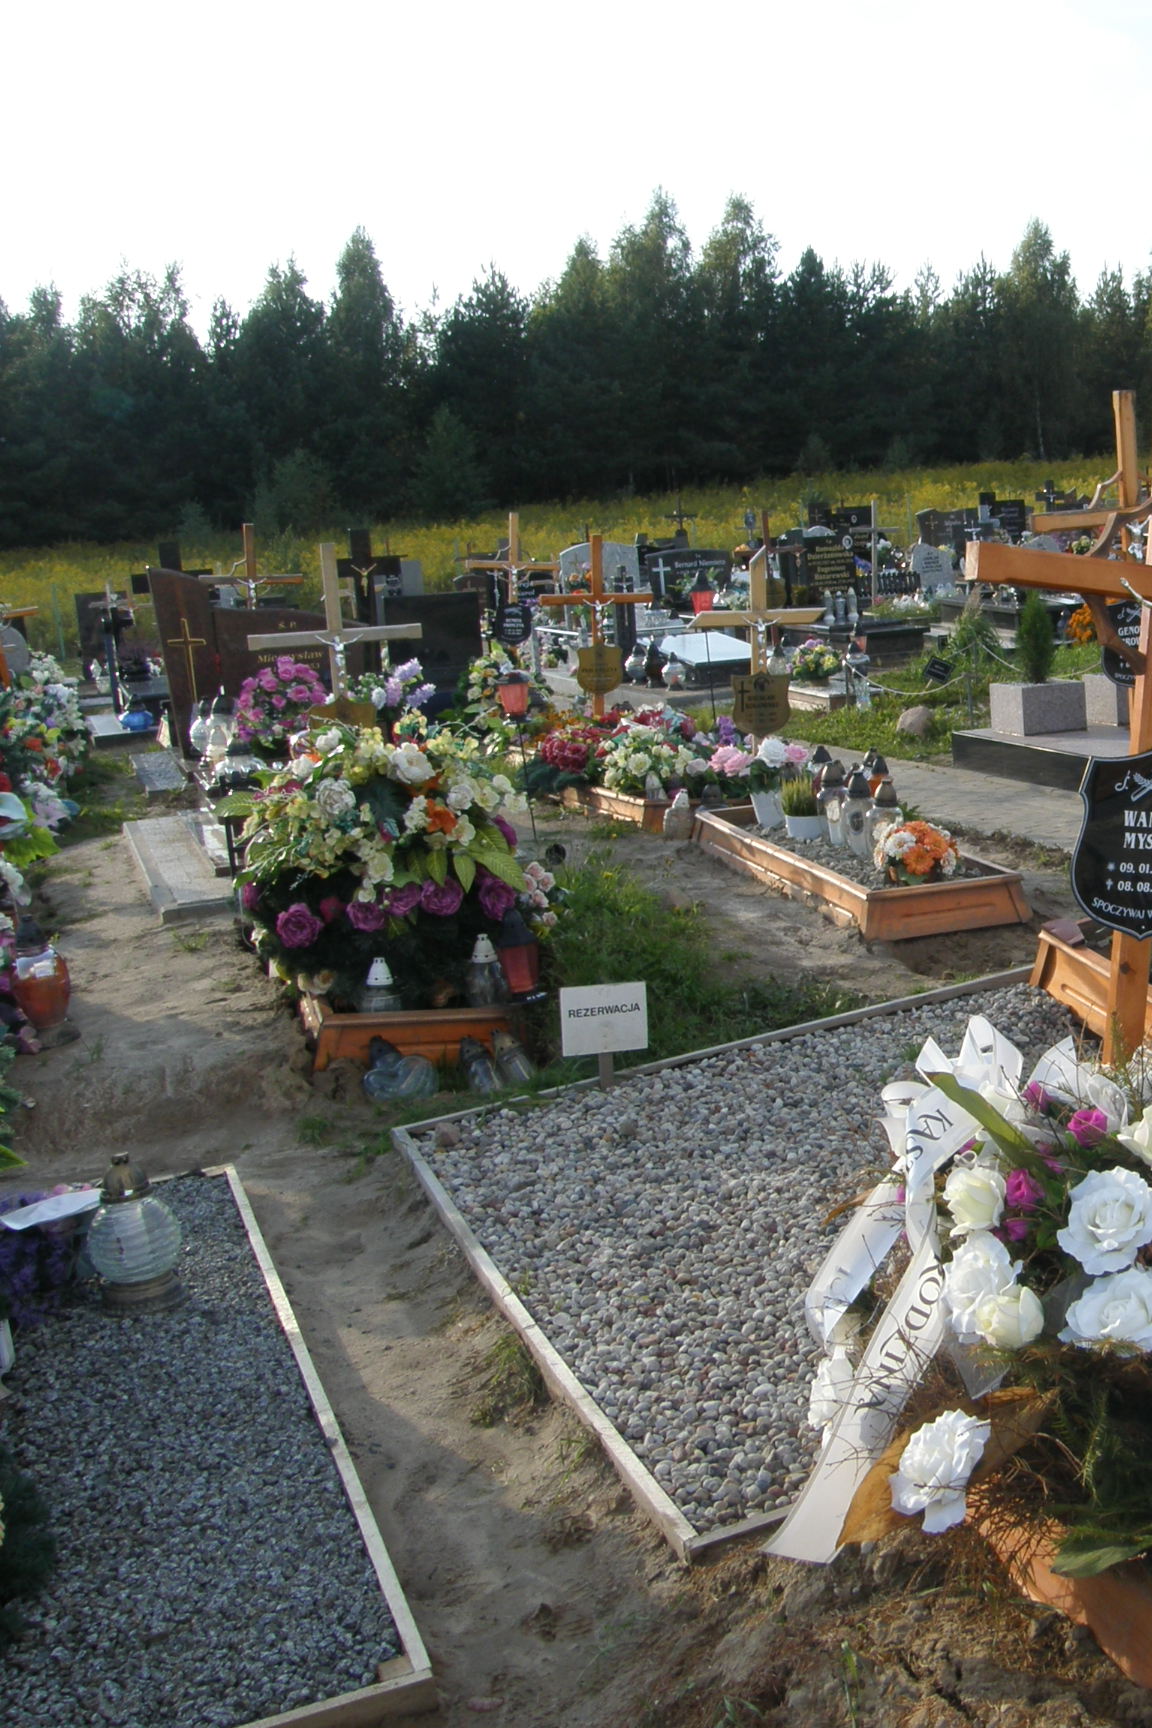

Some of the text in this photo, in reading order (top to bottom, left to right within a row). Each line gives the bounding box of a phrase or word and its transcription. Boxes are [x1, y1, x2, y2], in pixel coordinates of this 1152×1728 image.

[1119, 862, 1136, 874] 09.
[1138, 863, 1152, 875] 01.
[1117, 880, 1135, 892] 08.
[1091, 897, 1146, 919] SPOCZYWAJ
[568, 1003, 641, 1018] REZERWACJA
